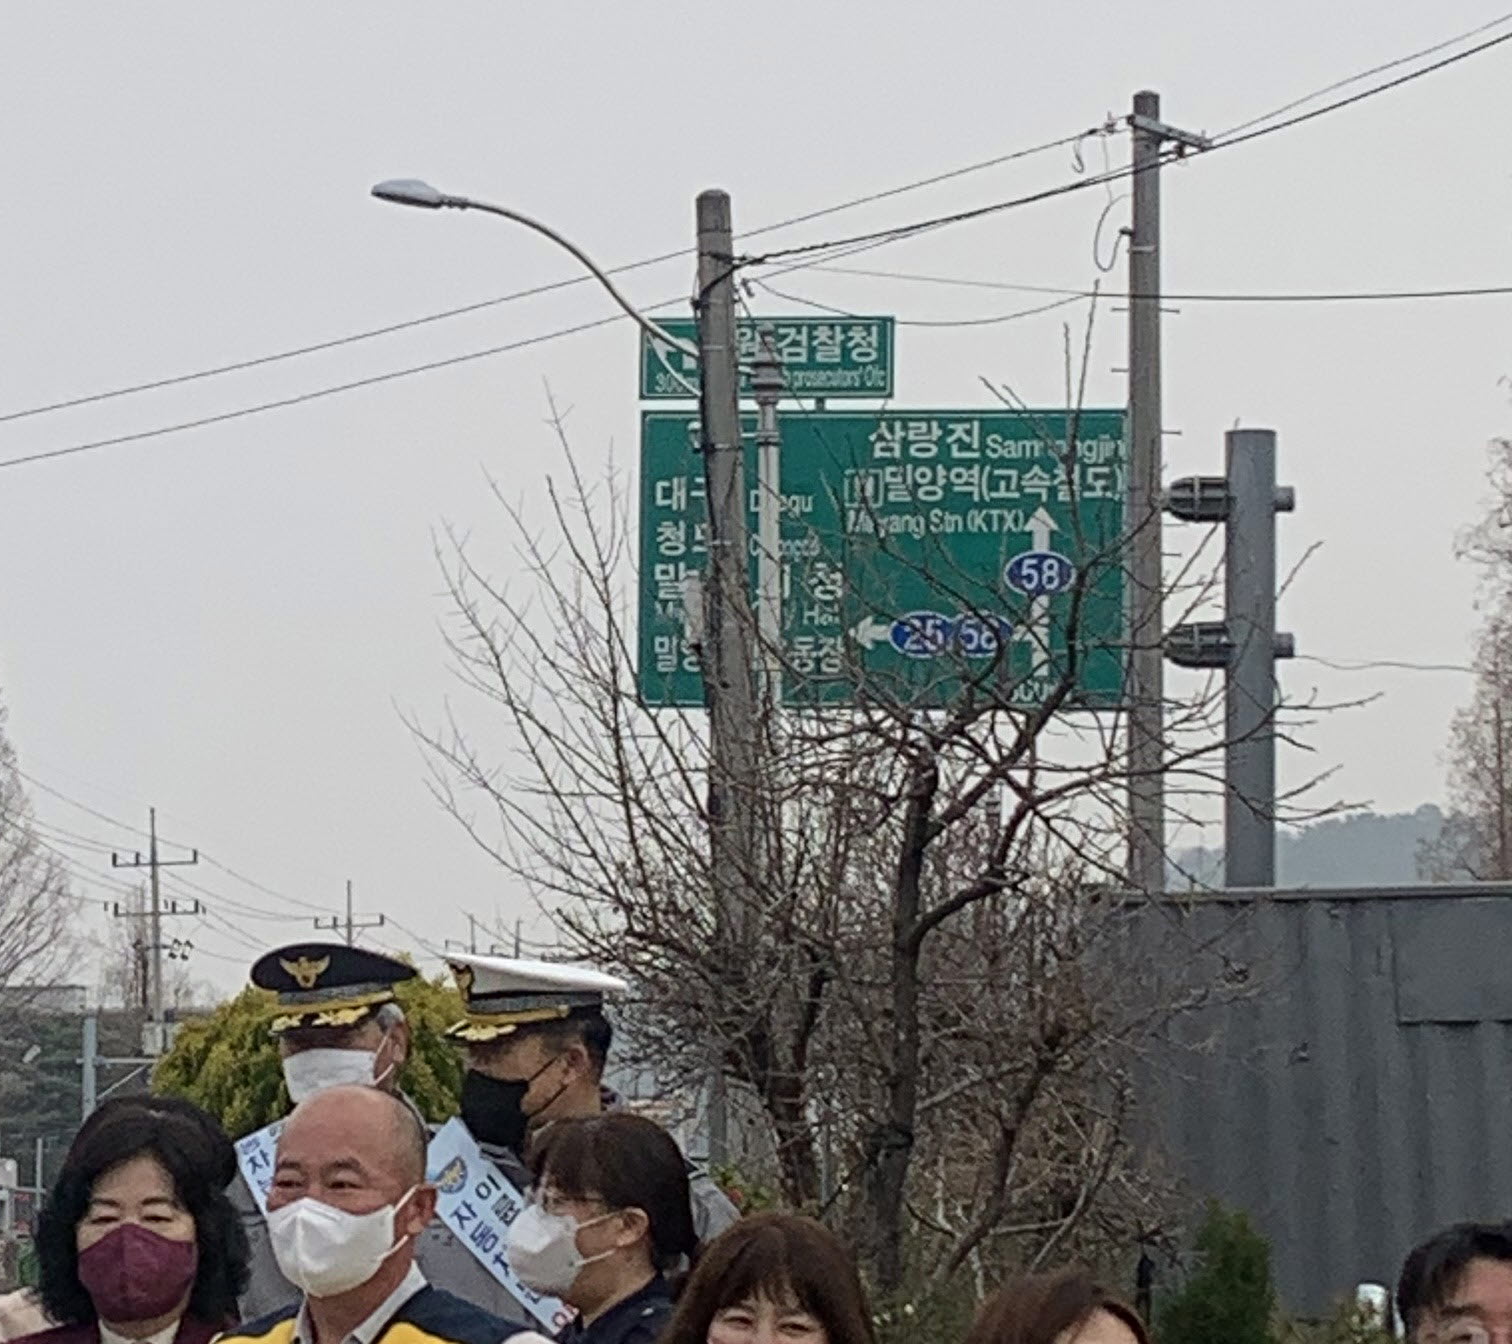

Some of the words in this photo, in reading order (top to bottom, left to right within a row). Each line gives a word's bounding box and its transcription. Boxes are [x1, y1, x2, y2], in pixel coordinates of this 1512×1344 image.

[868, 420, 982, 460] 삼랑진
[884, 464, 1124, 503] 밀양역(고속철도)
[929, 509, 964, 533] Stn
[967, 509, 1025, 534] (KTX)
[1020, 558, 1061, 591] 58
